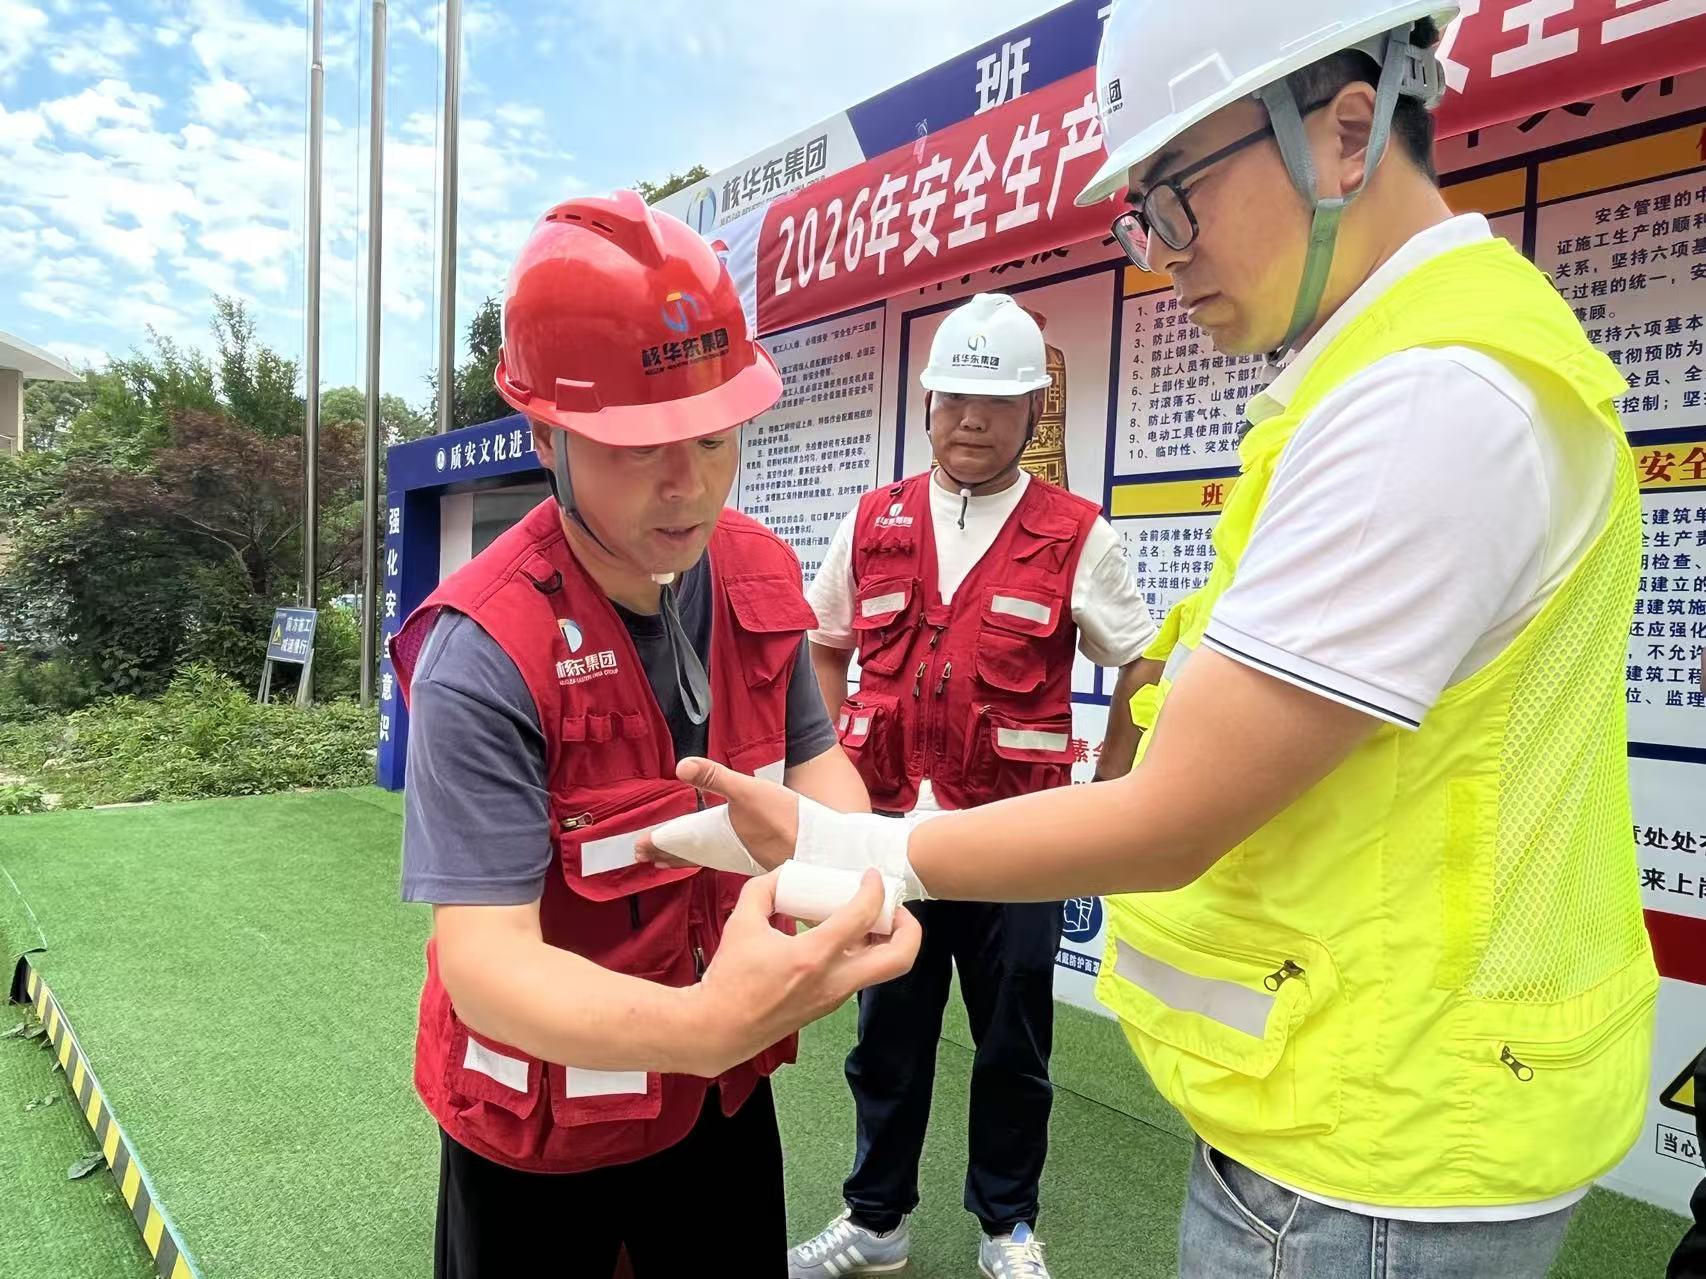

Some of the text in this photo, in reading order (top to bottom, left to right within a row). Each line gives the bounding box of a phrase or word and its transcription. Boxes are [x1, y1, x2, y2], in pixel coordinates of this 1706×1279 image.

[974, 37, 1031, 117] 班
[721, 134, 828, 213] 核华东集团
[1134, 327, 1210, 349] 3、防止吊机
[1615, 391, 1706, 414] 控制；坚
[450, 430, 537, 471] 质安文化进工
[1632, 825, 1706, 856] 处处
[1641, 868, 1706, 899] 来上
